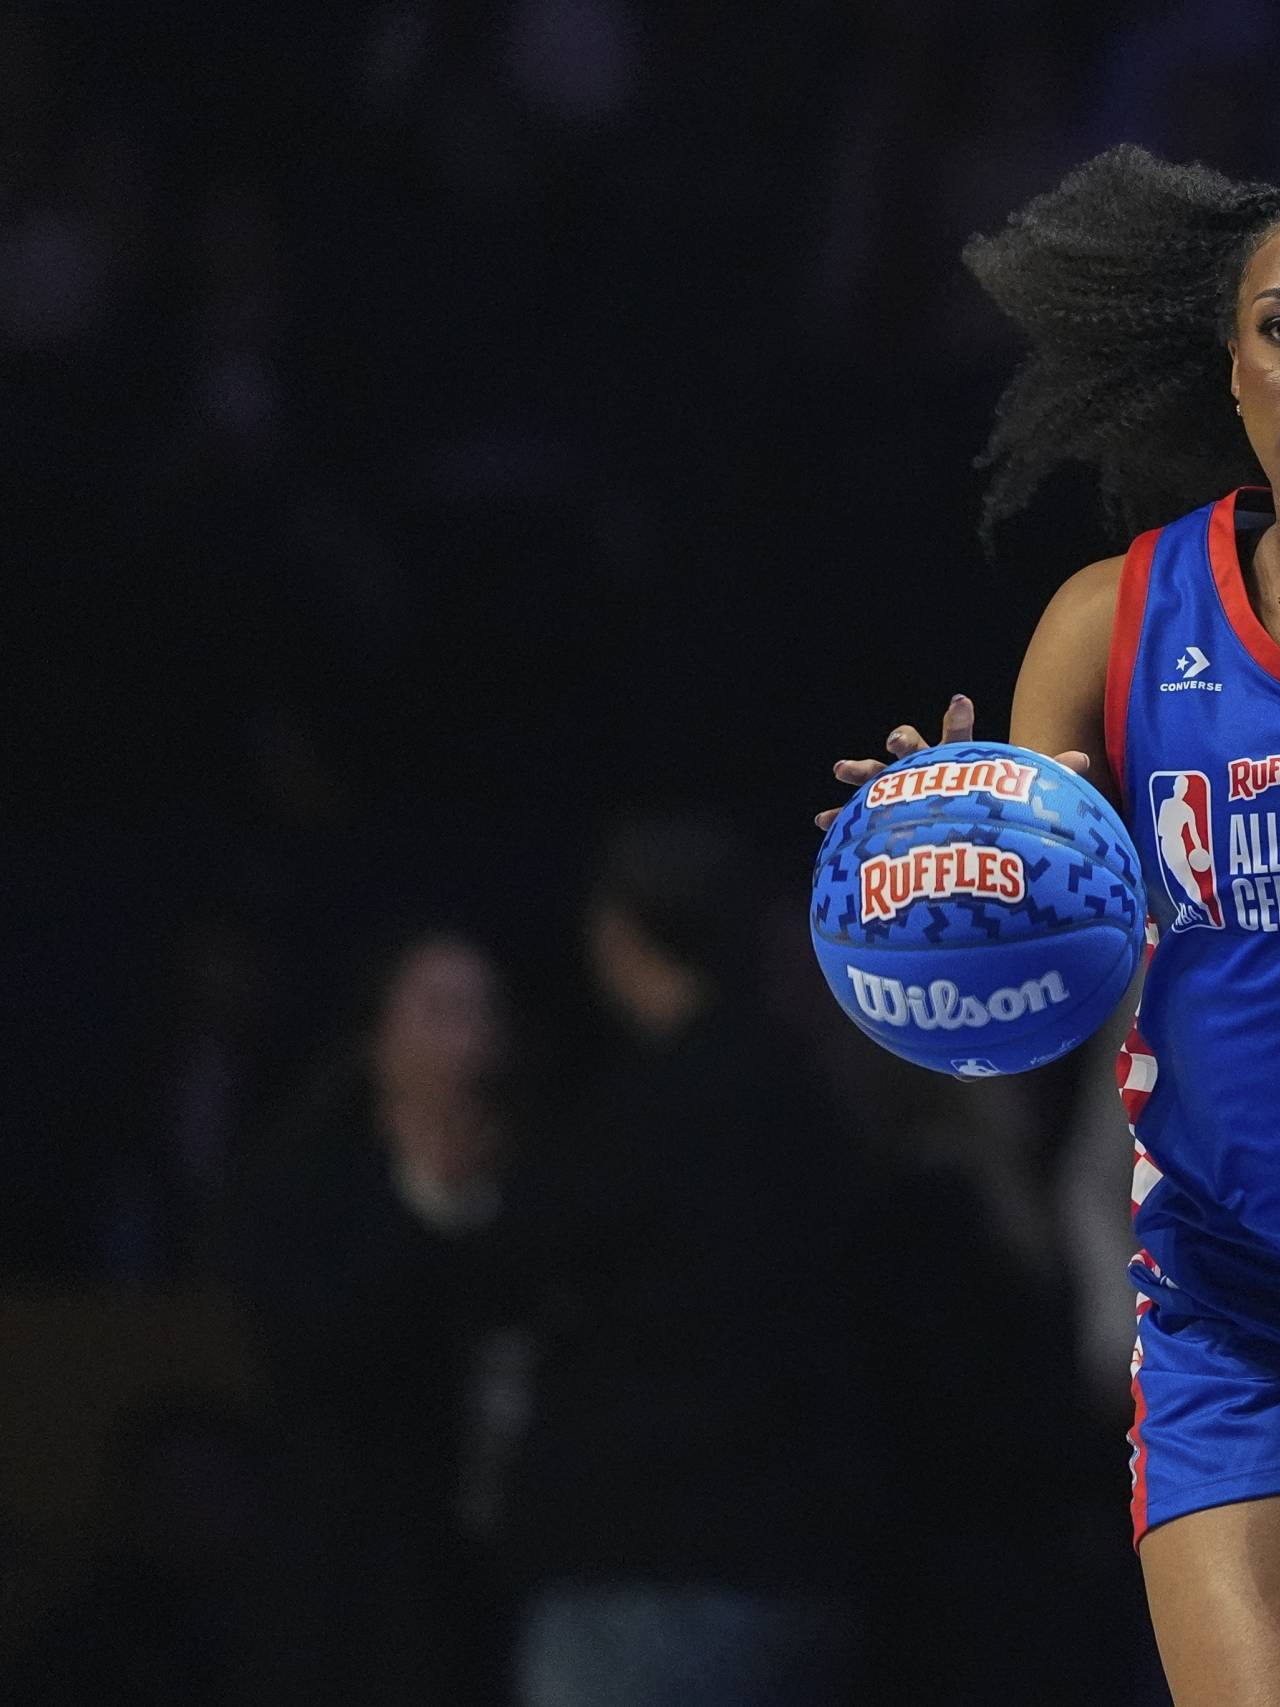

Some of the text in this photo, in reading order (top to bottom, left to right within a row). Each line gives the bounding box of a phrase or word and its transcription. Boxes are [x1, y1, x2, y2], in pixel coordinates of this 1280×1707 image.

[1160, 681, 1223, 692] CONVERSE
[867, 759, 1038, 808] RUFFLES
[861, 843, 1024, 923] RUFFLES
[847, 964, 1070, 1031] Wilson
